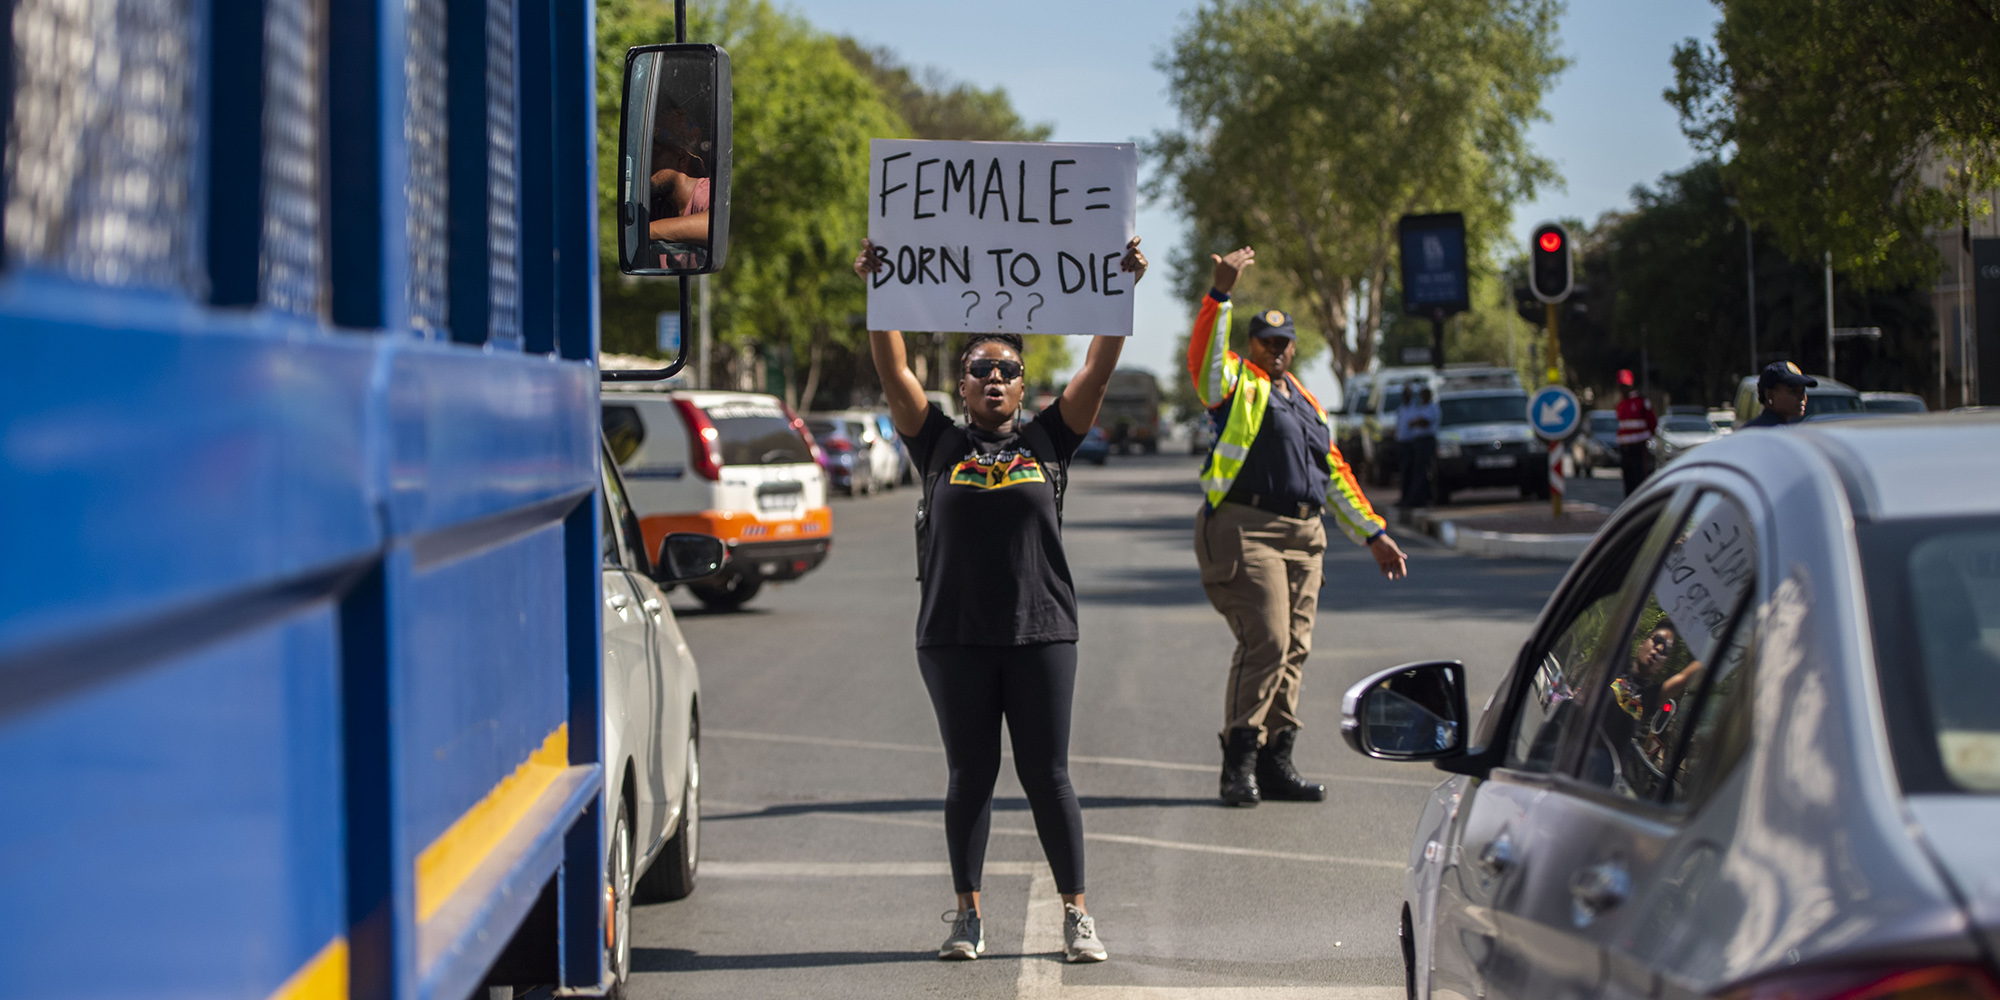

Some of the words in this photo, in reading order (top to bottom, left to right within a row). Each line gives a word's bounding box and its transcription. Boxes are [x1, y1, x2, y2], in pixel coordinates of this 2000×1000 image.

[873, 245, 971, 289] BORN
[987, 249, 1041, 287] TO
[1058, 251, 1124, 296] DIE
